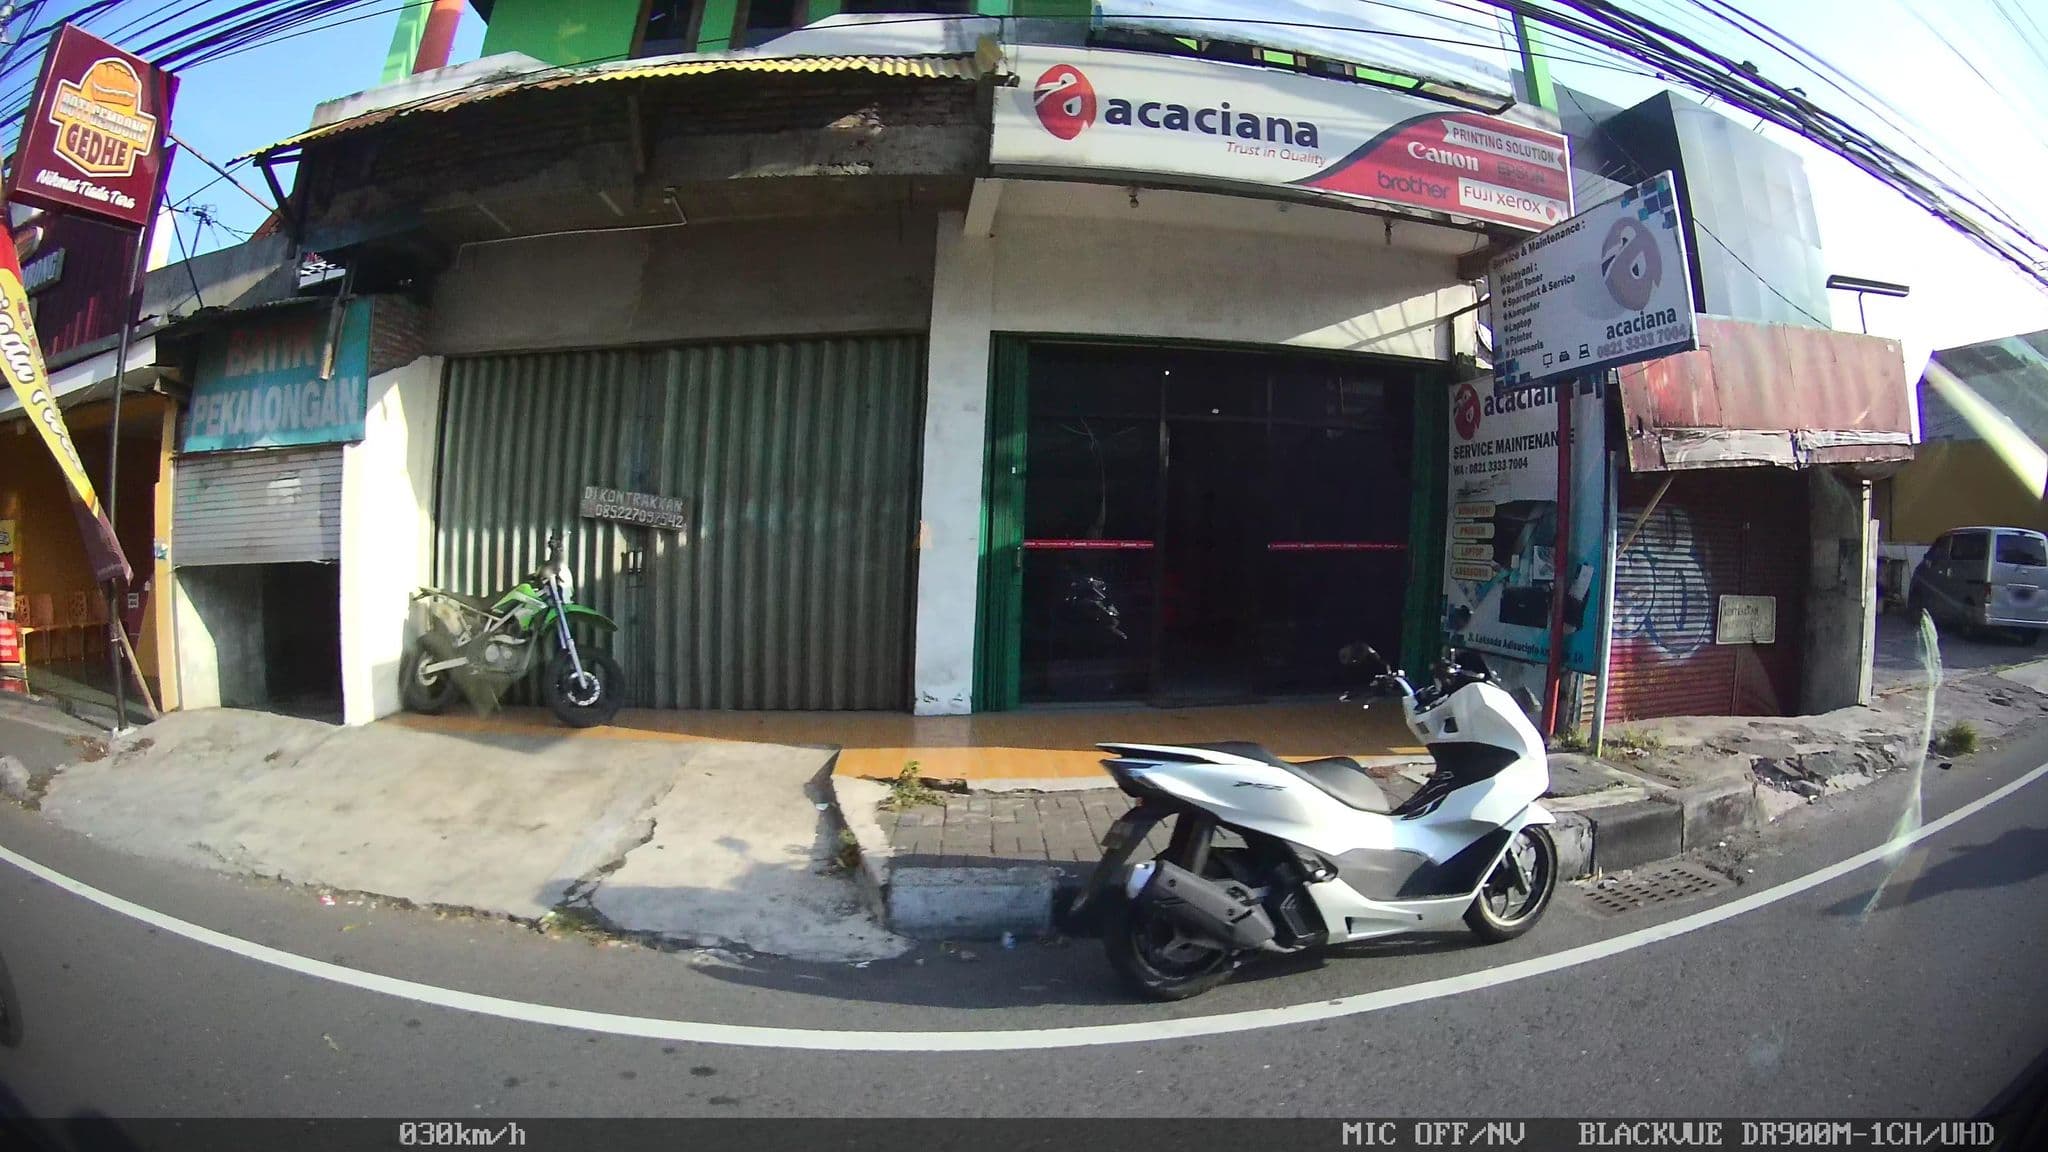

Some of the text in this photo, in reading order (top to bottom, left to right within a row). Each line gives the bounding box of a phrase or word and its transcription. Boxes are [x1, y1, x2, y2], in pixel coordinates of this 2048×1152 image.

[1104, 98, 1319, 148] acaciana
[66, 123, 129, 166] GEDHE
[1226, 141, 1327, 168] Trust in Quality
[1407, 141, 1480, 172] Canon
[1453, 127, 1555, 163] PRINTING SOLUTION
[1377, 170, 1450, 199] brother
[1464, 186, 1542, 215] FUJI xerox
[1525, 273, 1543, 288] Toner
[1549, 274, 1576, 291] Service
[1509, 318, 1532, 333] Laptop
[1606, 307, 1677, 340] acaciana
[191, 376, 361, 437] PEKALONGAN
[1453, 428, 1575, 460] SERVICE MAINTENANE
[1469, 463, 1487, 475] 0821
[1488, 460, 1506, 472] 3333
[1508, 457, 1528, 470] 7004
